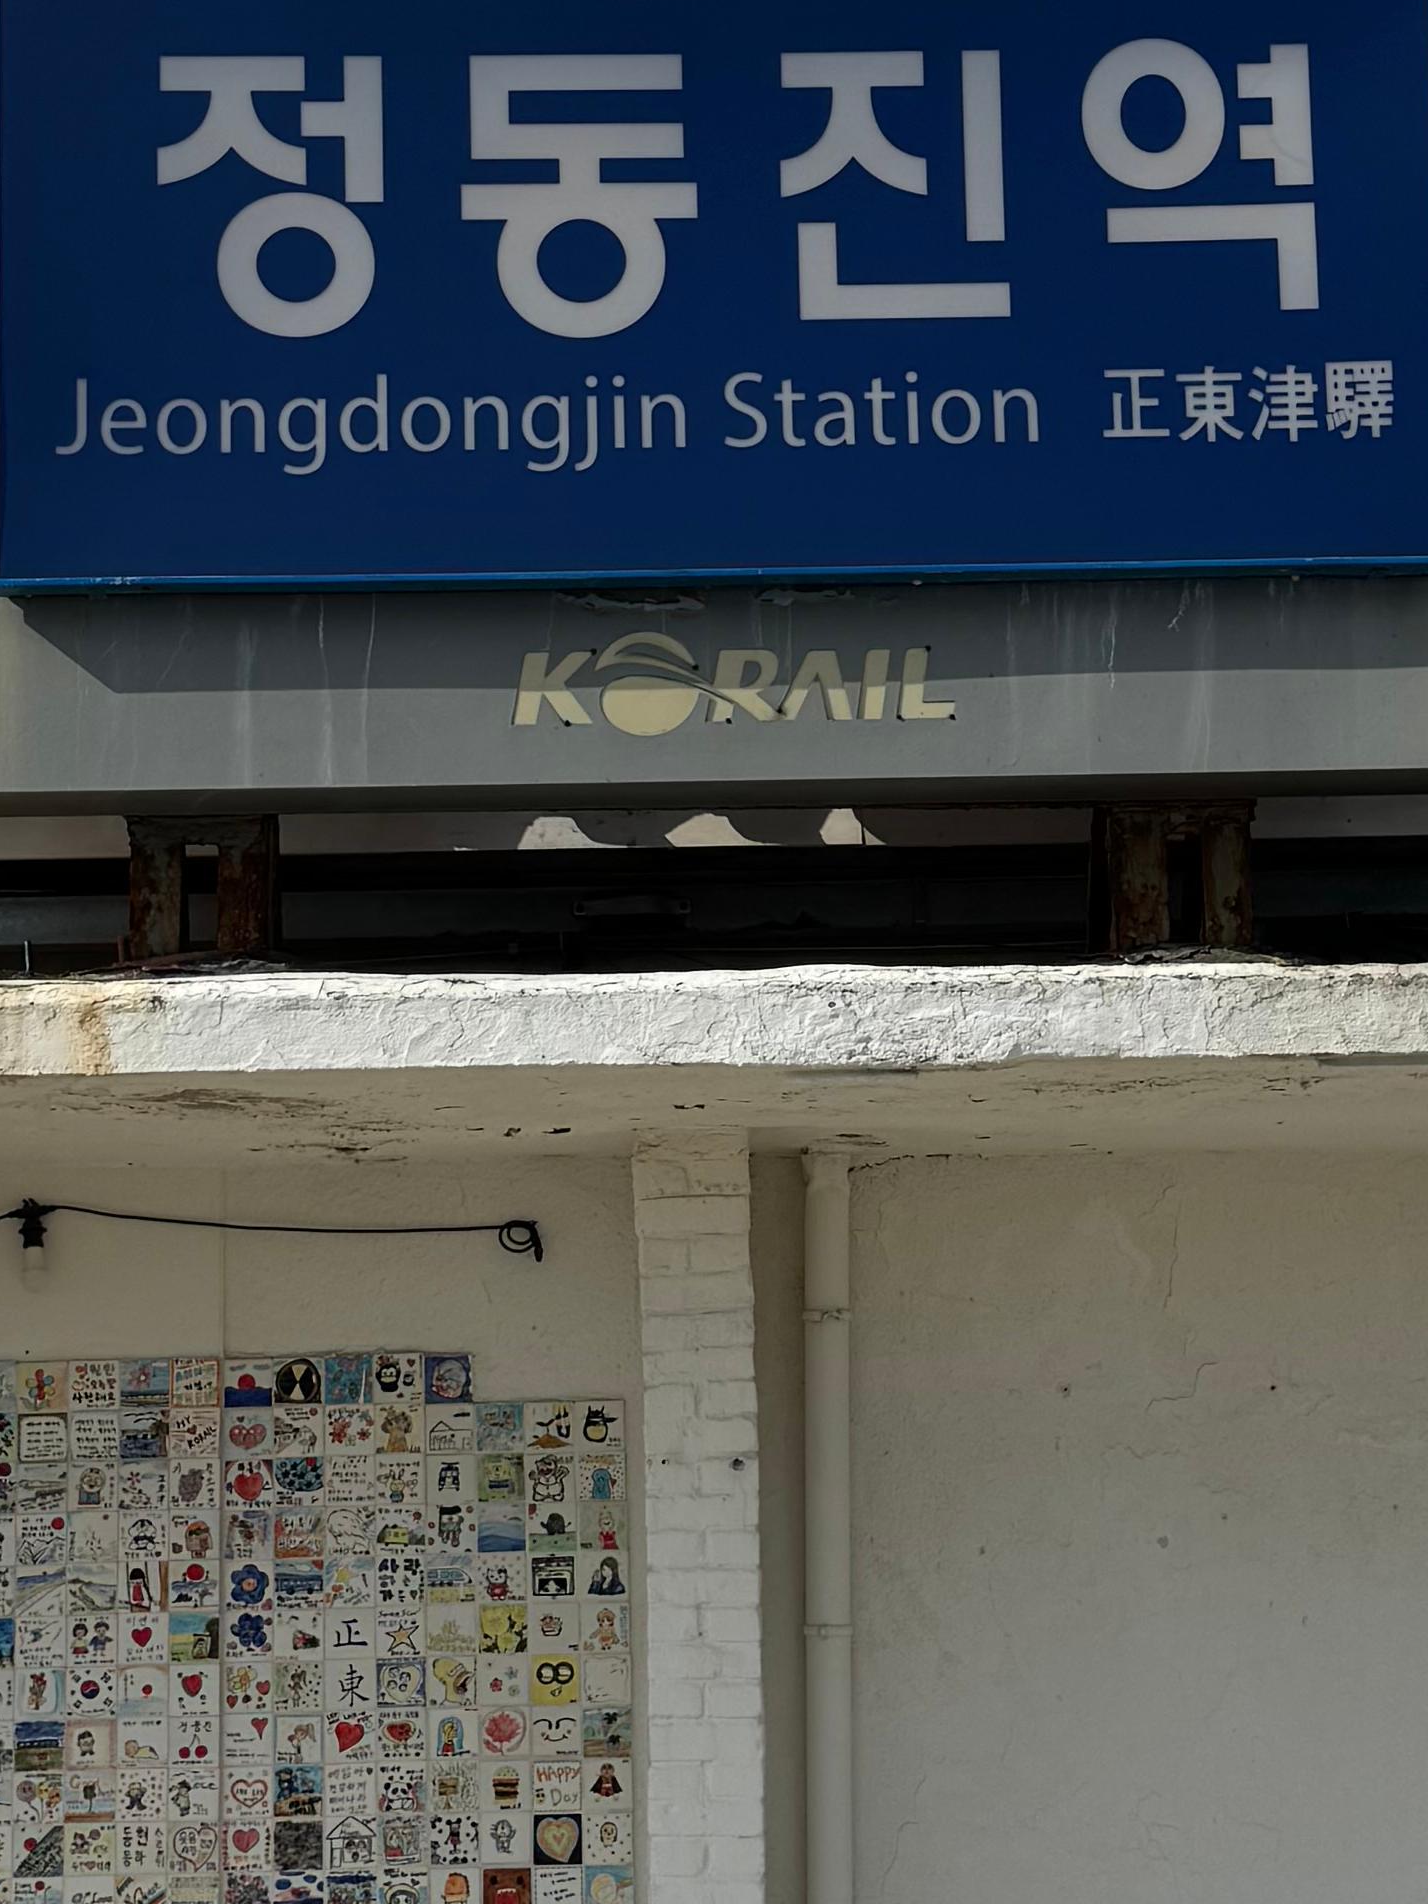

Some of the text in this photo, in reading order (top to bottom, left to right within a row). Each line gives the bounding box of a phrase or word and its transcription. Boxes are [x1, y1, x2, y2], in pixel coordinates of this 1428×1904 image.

[156, 37, 1320, 339] 정동진역
[56, 370, 1040, 475] Jeongdongjin Station
[1103, 360, 1395, 443] 正東津驛
[512, 630, 956, 737] KORAIL
[536, 1767, 581, 1787] HAPPY
